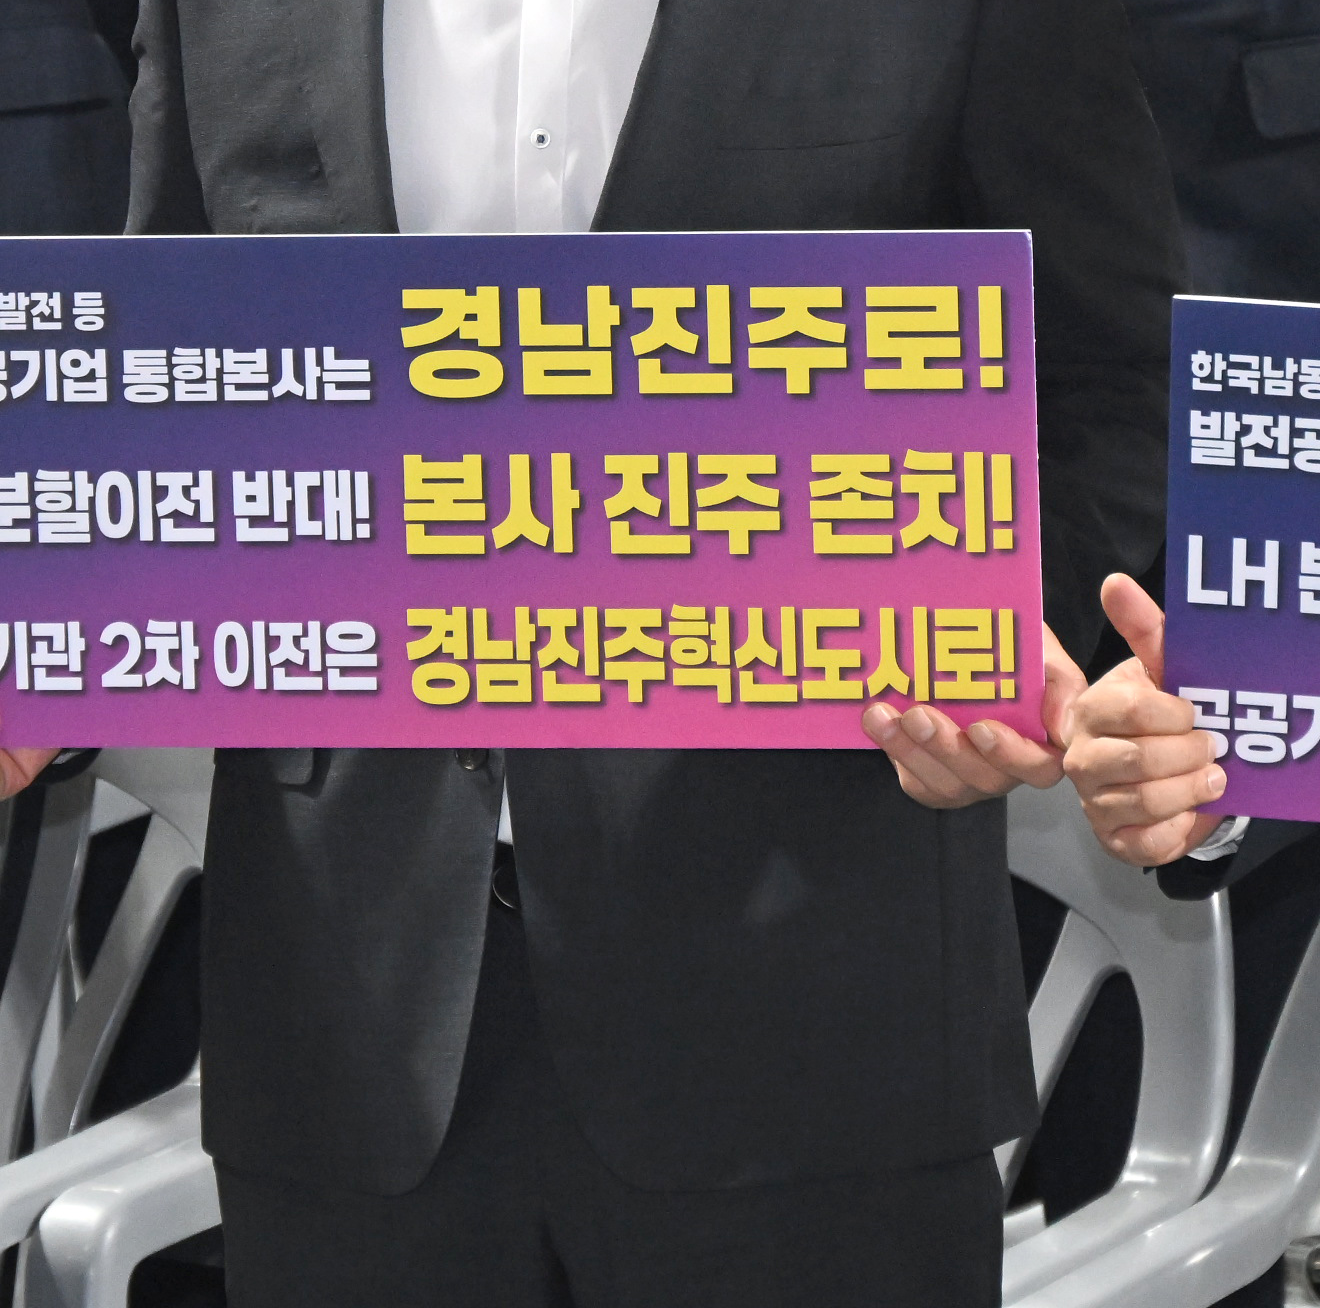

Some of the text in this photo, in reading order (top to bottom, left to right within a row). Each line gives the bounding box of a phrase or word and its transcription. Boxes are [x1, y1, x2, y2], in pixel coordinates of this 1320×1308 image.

[73, 292, 104, 331] 등
[123, 347, 370, 403] 통합본사는
[401, 285, 1003, 398] 경남진주로!
[233, 470, 370, 541] 반대!
[403, 453, 579, 554] 본사
[604, 453, 780, 554] 진주
[809, 449, 1013, 553] 존치!
[1187, 535, 1279, 608] LH
[100, 620, 199, 689] 2차
[214, 621, 377, 690] 이전은
[406, 604, 1015, 704] 경남진주혁신도시로!
